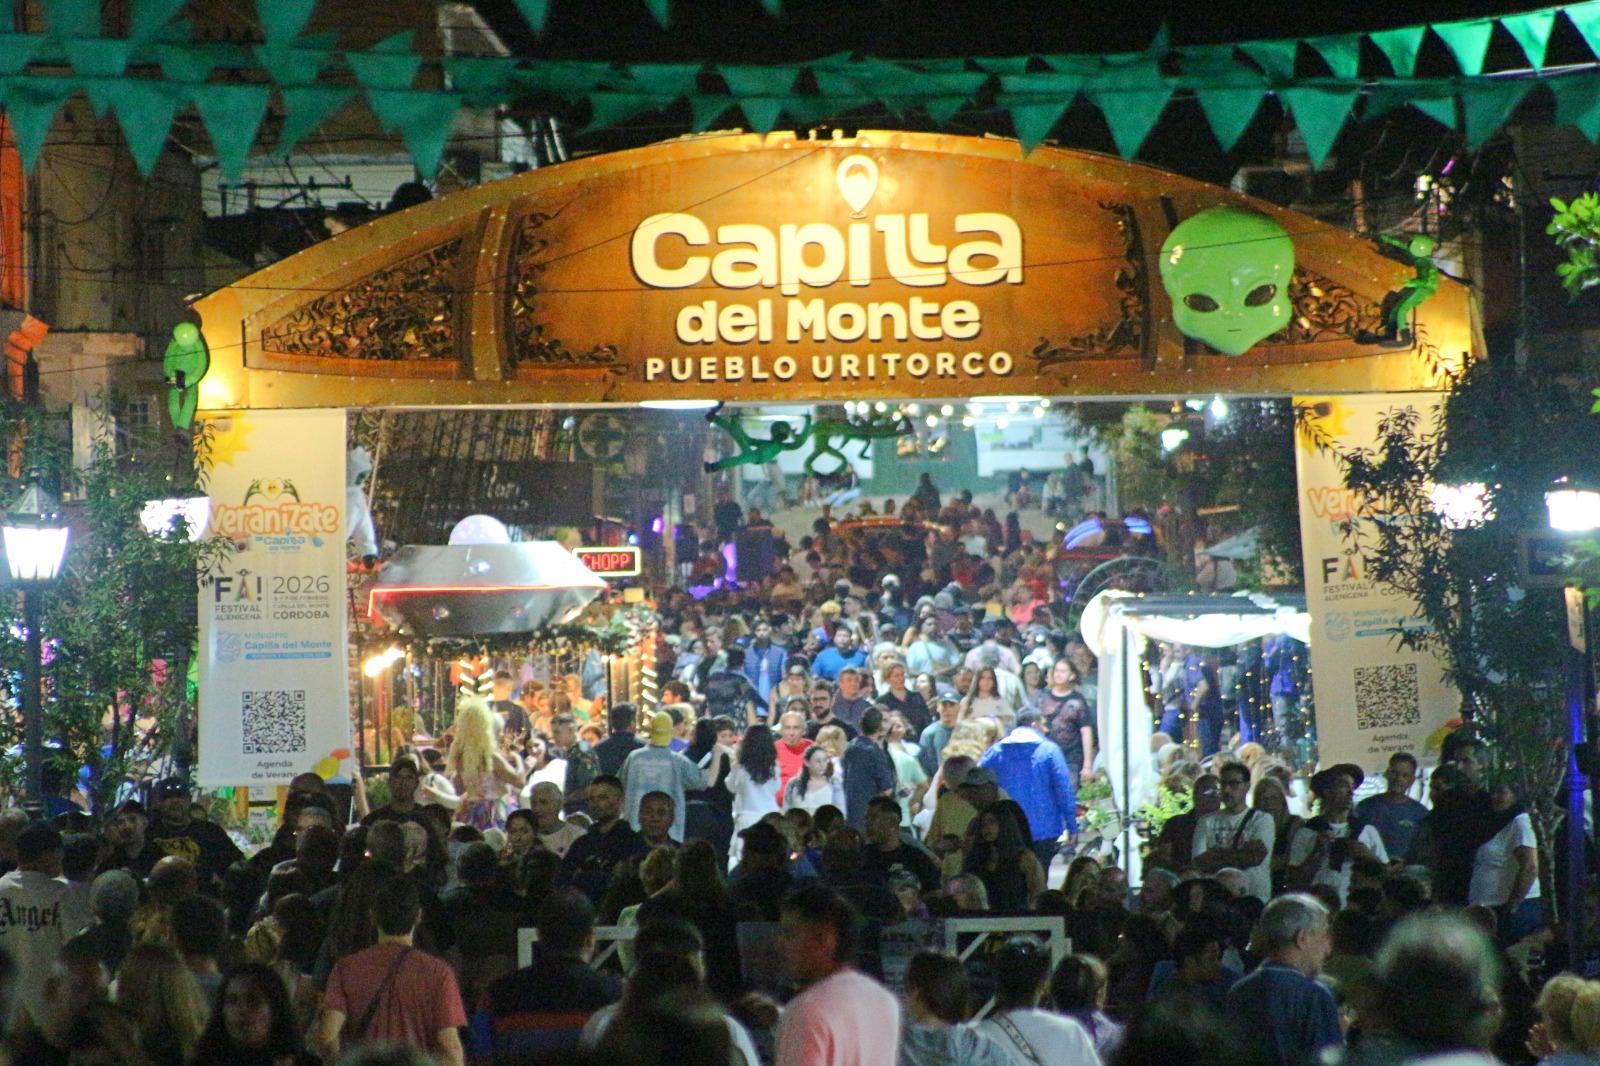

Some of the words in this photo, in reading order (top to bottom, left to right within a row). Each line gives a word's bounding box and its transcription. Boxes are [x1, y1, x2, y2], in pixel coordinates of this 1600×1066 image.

[630, 211, 1024, 296] Capilla
[676, 298, 774, 344] del
[787, 297, 981, 342] Monte
[645, 355, 799, 382] PUEBLO
[811, 351, 1014, 380] URITORCO
[272, 575, 330, 594] 2026
[1323, 584, 1369, 594] FESTIVAL
[215, 603, 262, 613] FESTIVAL
[244, 641, 280, 651] Capilla
[282, 641, 298, 649] del
[301, 640, 332, 649] Monte
[1373, 733, 1408, 742] Agenda
[1382, 744, 1415, 753] Verano
[256, 761, 293, 769] Agenda
